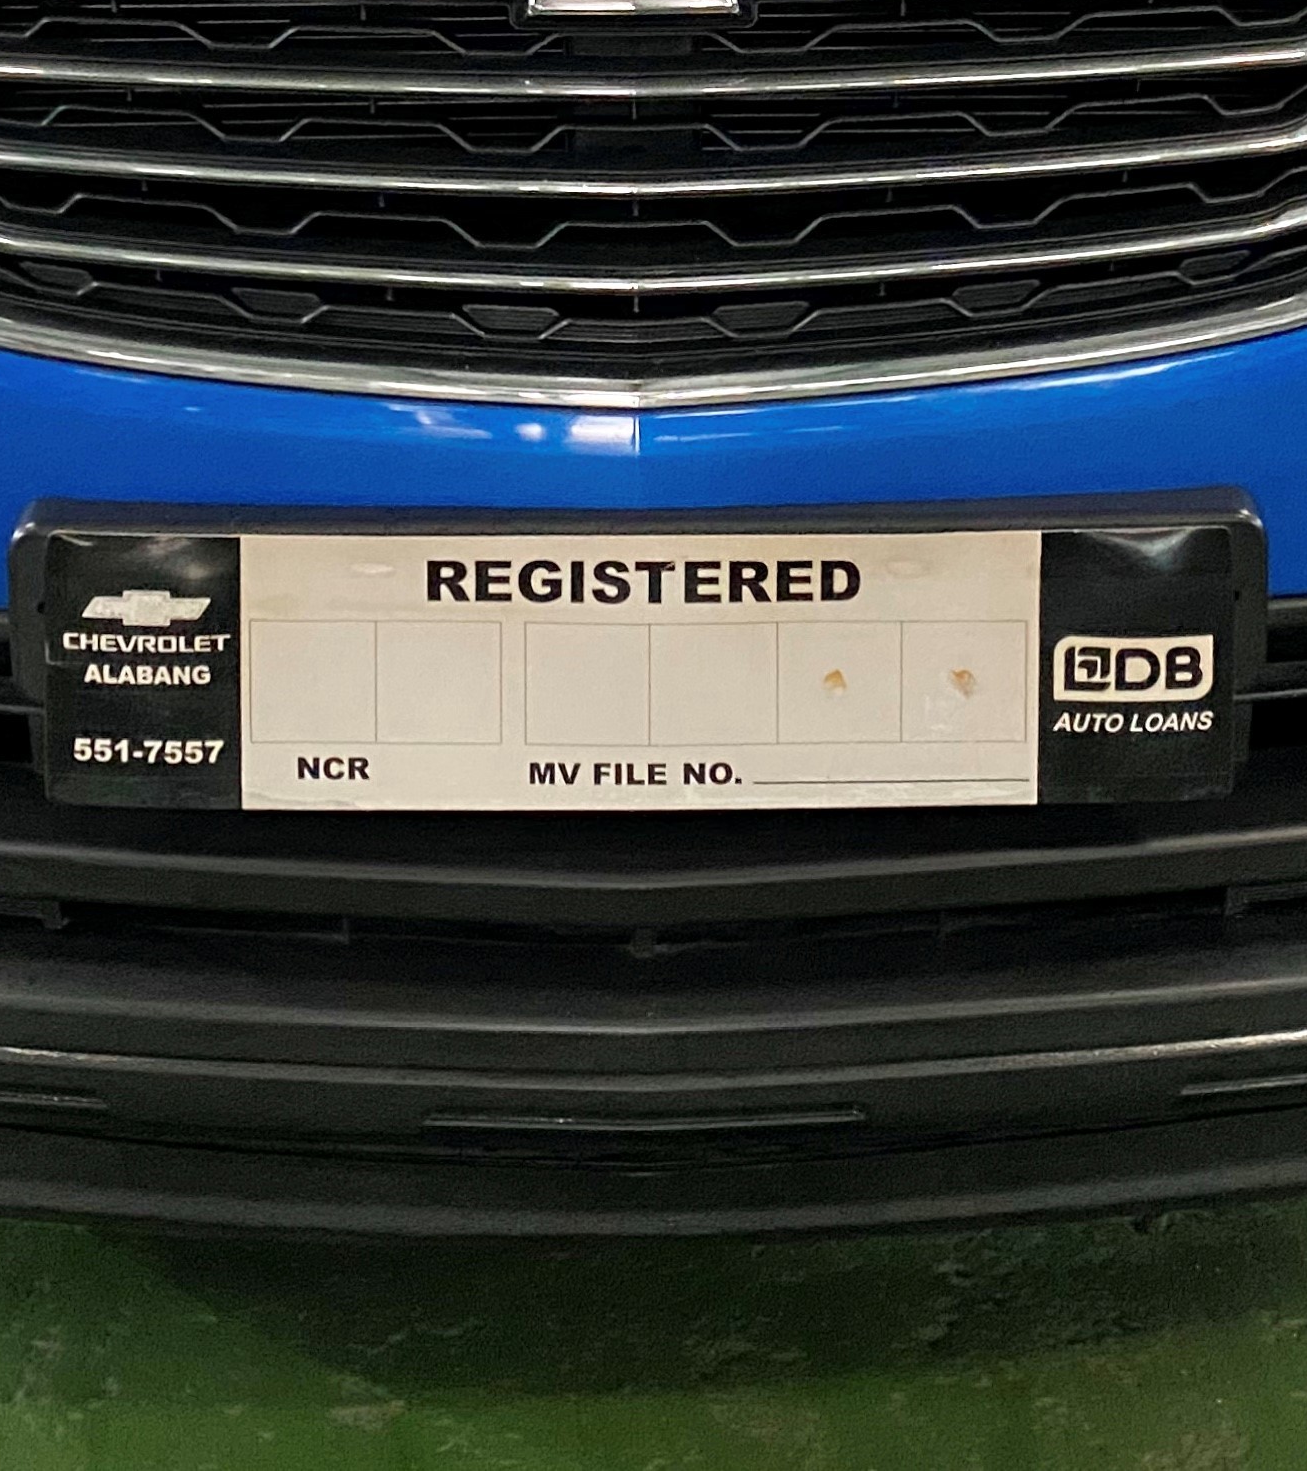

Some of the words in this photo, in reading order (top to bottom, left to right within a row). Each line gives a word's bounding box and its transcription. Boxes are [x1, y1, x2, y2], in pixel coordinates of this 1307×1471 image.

[426, 559, 860, 603] REGISTERED
[62, 632, 231, 653] CHEVROLET
[83, 663, 212, 685] ALABANG
[1052, 711, 1124, 733] AUTO
[1129, 710, 1214, 733] LOANS
[72, 737, 226, 764] 551-7557
[297, 756, 370, 779] NCR
[528, 762, 581, 786] MV
[593, 762, 667, 786] FILE
[683, 762, 743, 786] NO.
